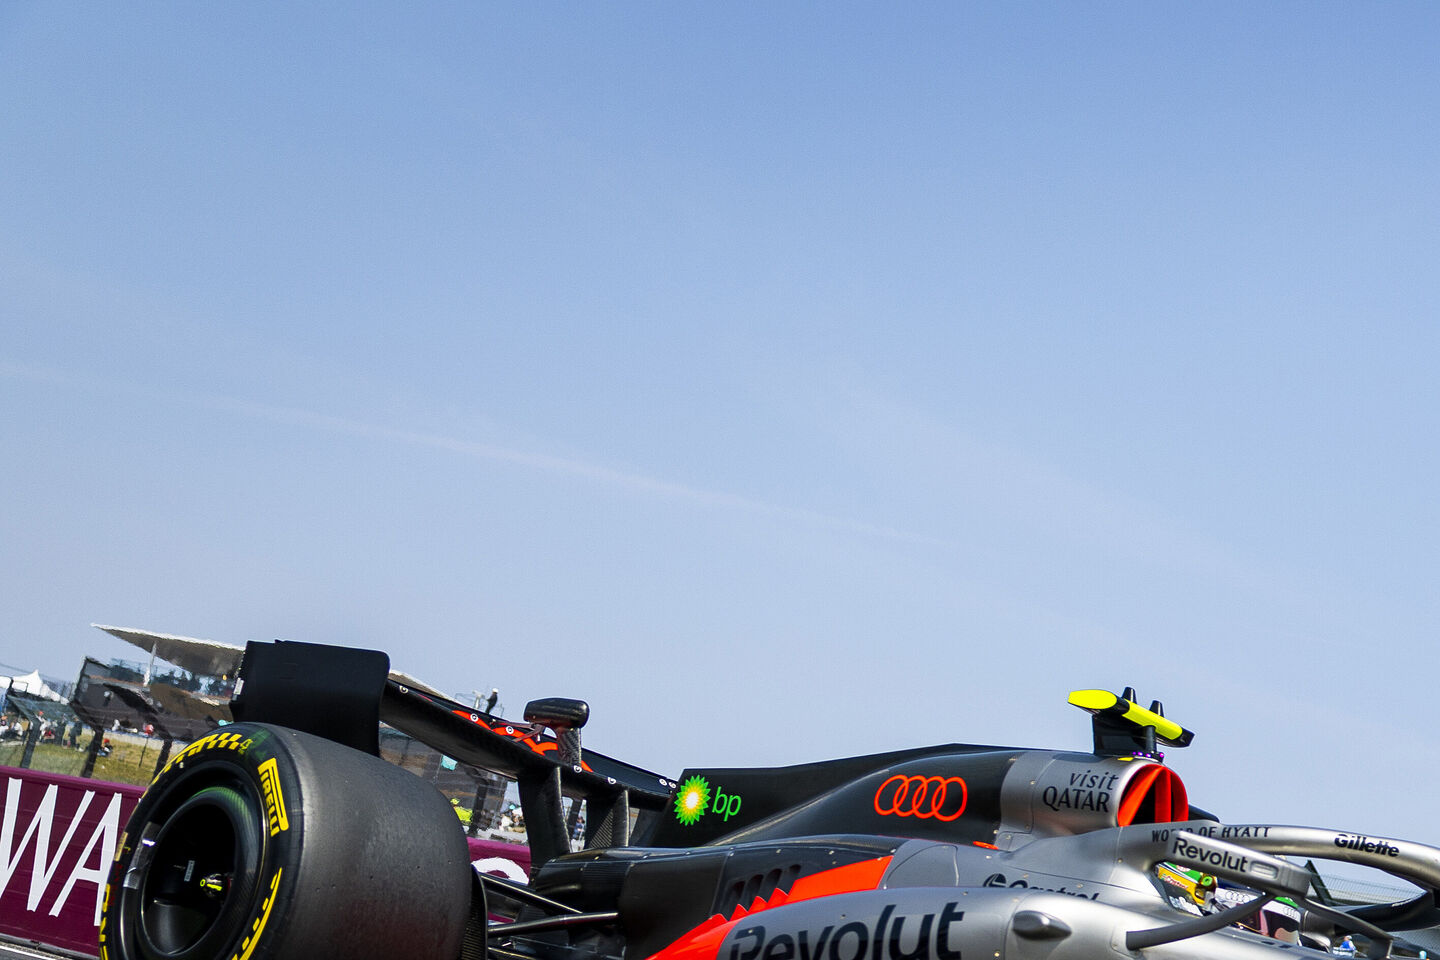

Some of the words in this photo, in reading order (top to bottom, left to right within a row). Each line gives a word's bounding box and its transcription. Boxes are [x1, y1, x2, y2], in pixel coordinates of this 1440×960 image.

[1069, 769, 1119, 791] visit
[257, 757, 290, 837] PIRELLI
[711, 785, 742, 822] bp
[1042, 785, 1111, 813] QATAR
[1221, 826, 1272, 839] HYATT
[1334, 833, 1400, 857] Gillette
[0, 777, 141, 927] WA
[1172, 837, 1248, 873] Revolut
